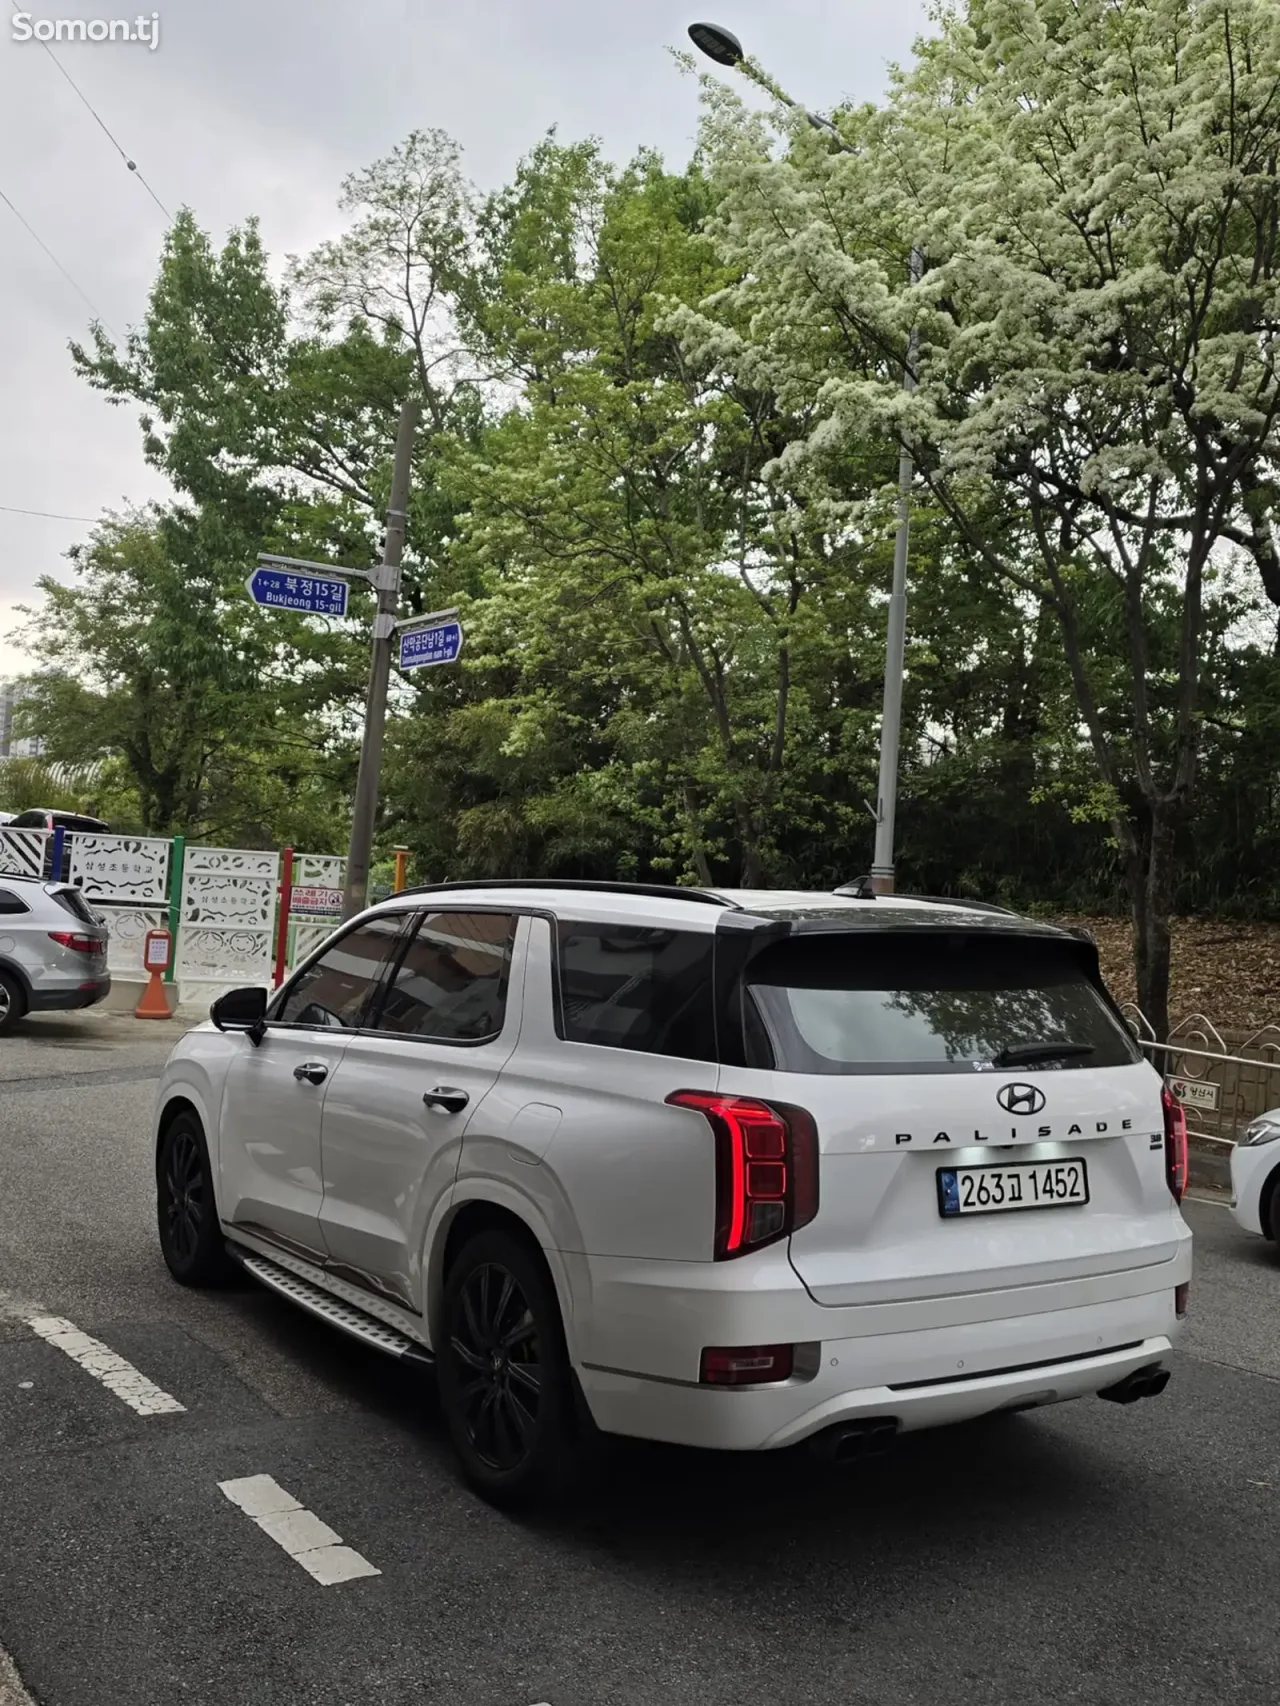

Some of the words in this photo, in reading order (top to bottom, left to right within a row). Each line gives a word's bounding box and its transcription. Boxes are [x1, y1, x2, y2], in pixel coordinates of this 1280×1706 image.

[284, 577, 343, 601] 북정15길
[266, 592, 311, 609] Bukjeong
[315, 600, 342, 613] 15-gil
[85, 862, 153, 874] 삼성초등학교
[292, 896, 328, 906] 배출금지
[293, 889, 328, 898] 쓰레기
[895, 1119, 1132, 1145] PALISADE
[961, 1173, 1023, 1207] 263고
[1028, 1166, 1081, 1201] 1452
